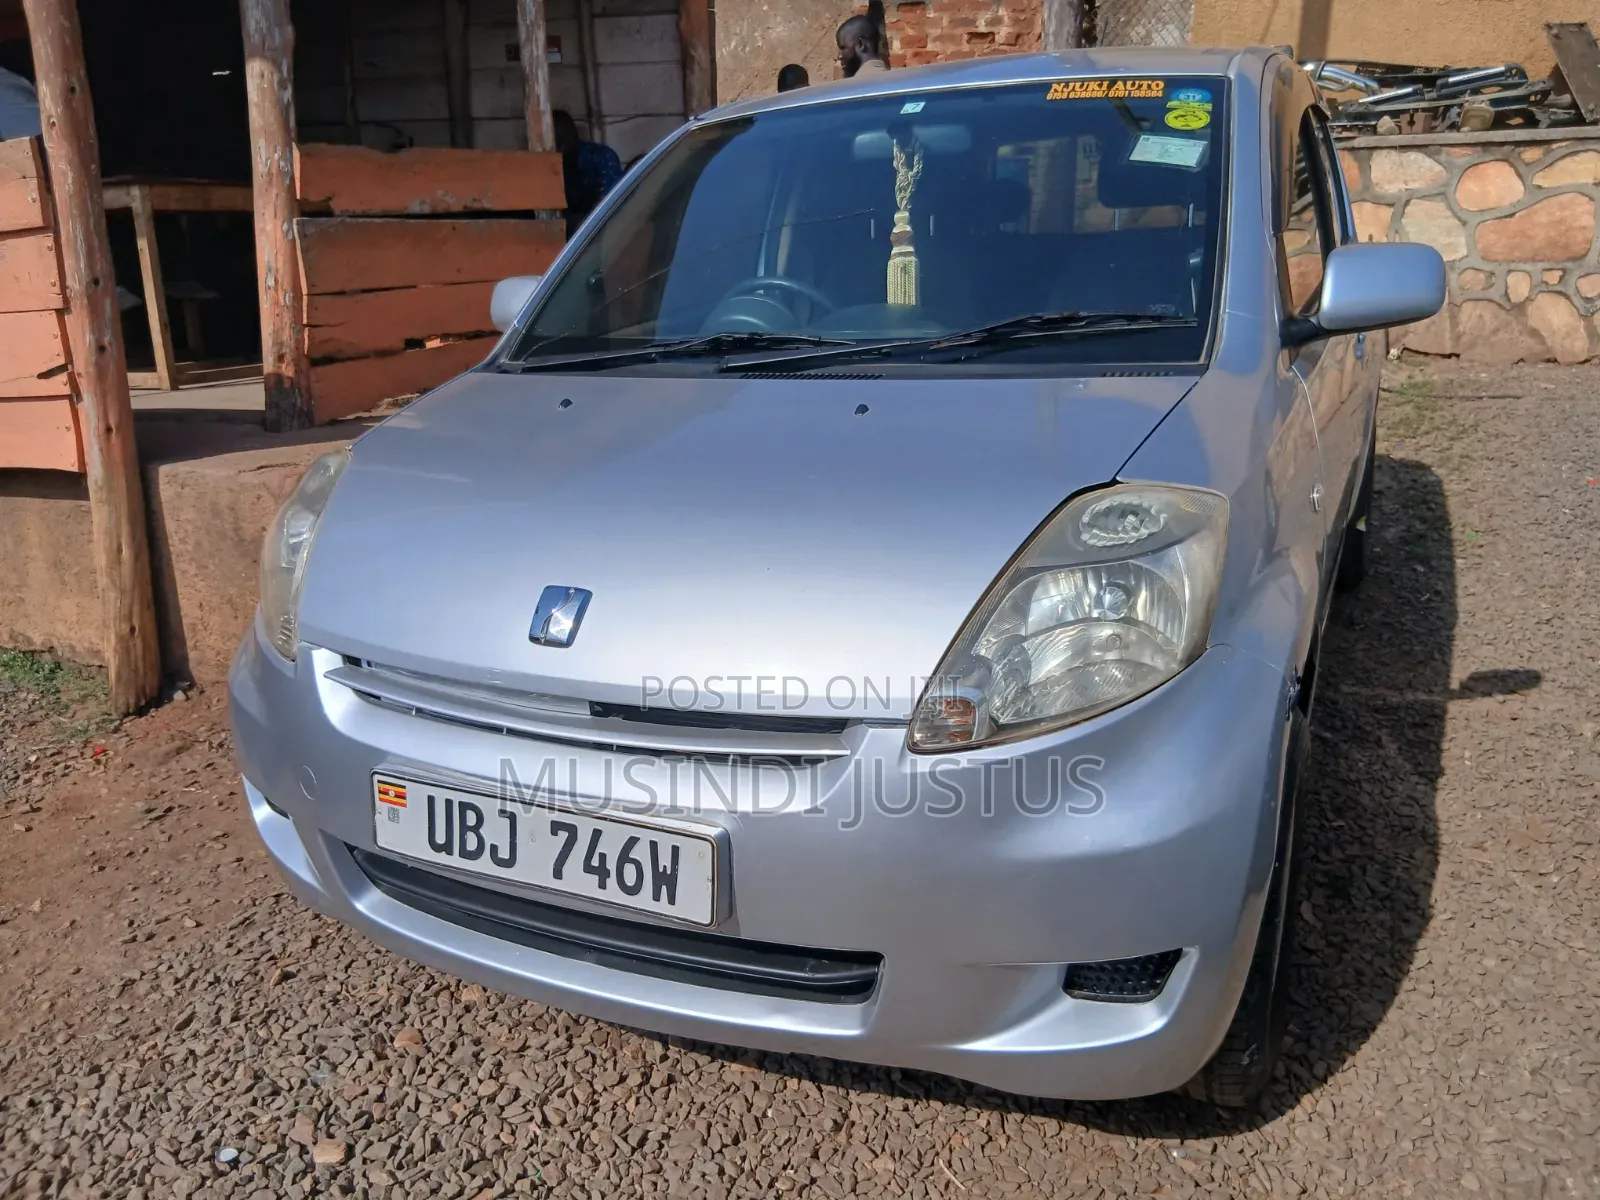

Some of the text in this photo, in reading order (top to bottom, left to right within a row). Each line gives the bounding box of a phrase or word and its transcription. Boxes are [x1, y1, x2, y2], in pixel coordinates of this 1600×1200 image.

[1050, 80, 1164, 93] NJUKI AUTO
[1108, 90, 1128, 98] 0701
[427, 794, 681, 906] UBJ 746W
